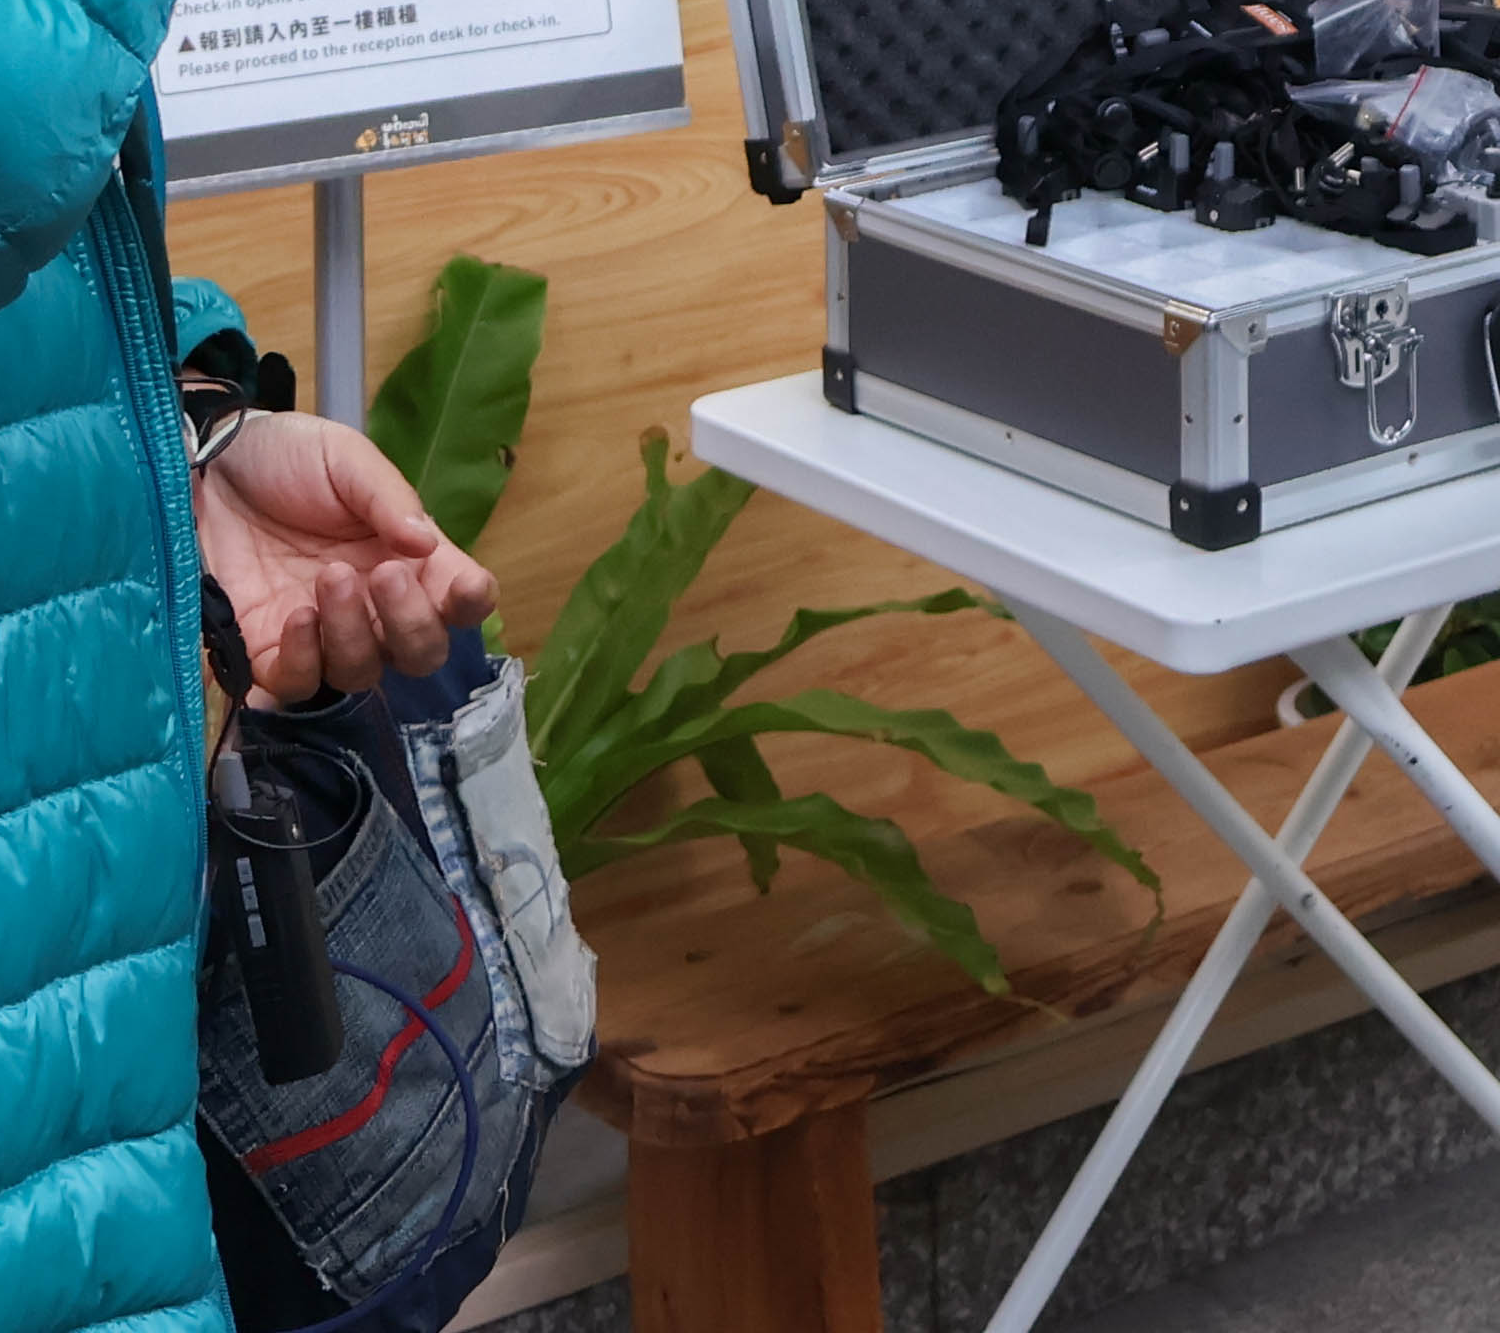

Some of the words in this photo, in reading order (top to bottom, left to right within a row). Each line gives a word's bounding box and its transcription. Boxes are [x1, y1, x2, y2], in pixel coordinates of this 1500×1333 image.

[179, 58, 229, 78] Please
[235, 49, 298, 74] proceed
[302, 47, 317, 62] to
[323, 42, 348, 58] the
[353, 31, 424, 54] reception
[430, 25, 463, 44] desk
[469, 22, 489, 38] for
[493, 13, 560, 35] check-in.
